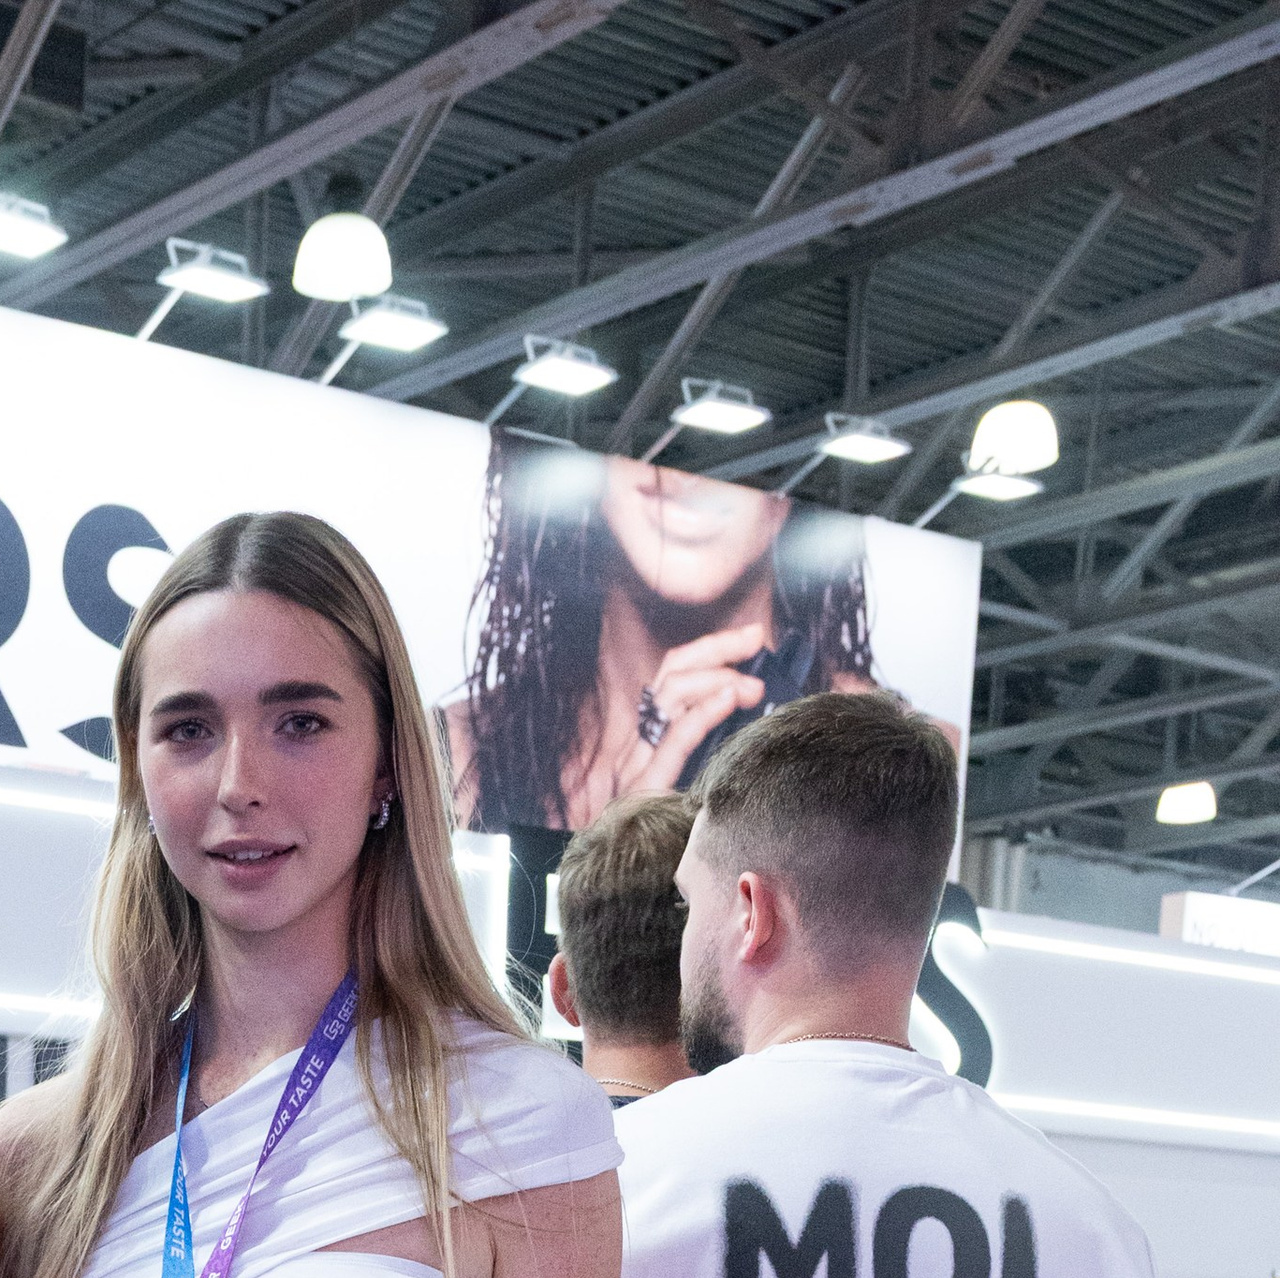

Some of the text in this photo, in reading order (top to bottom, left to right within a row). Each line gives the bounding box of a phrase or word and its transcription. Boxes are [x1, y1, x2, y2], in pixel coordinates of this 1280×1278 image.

[262, 1110, 291, 1157] YOUR
[288, 1054, 325, 1109] TASTE
[171, 1203, 185, 1260] TASTE
[220, 1200, 244, 1250] GEEK
